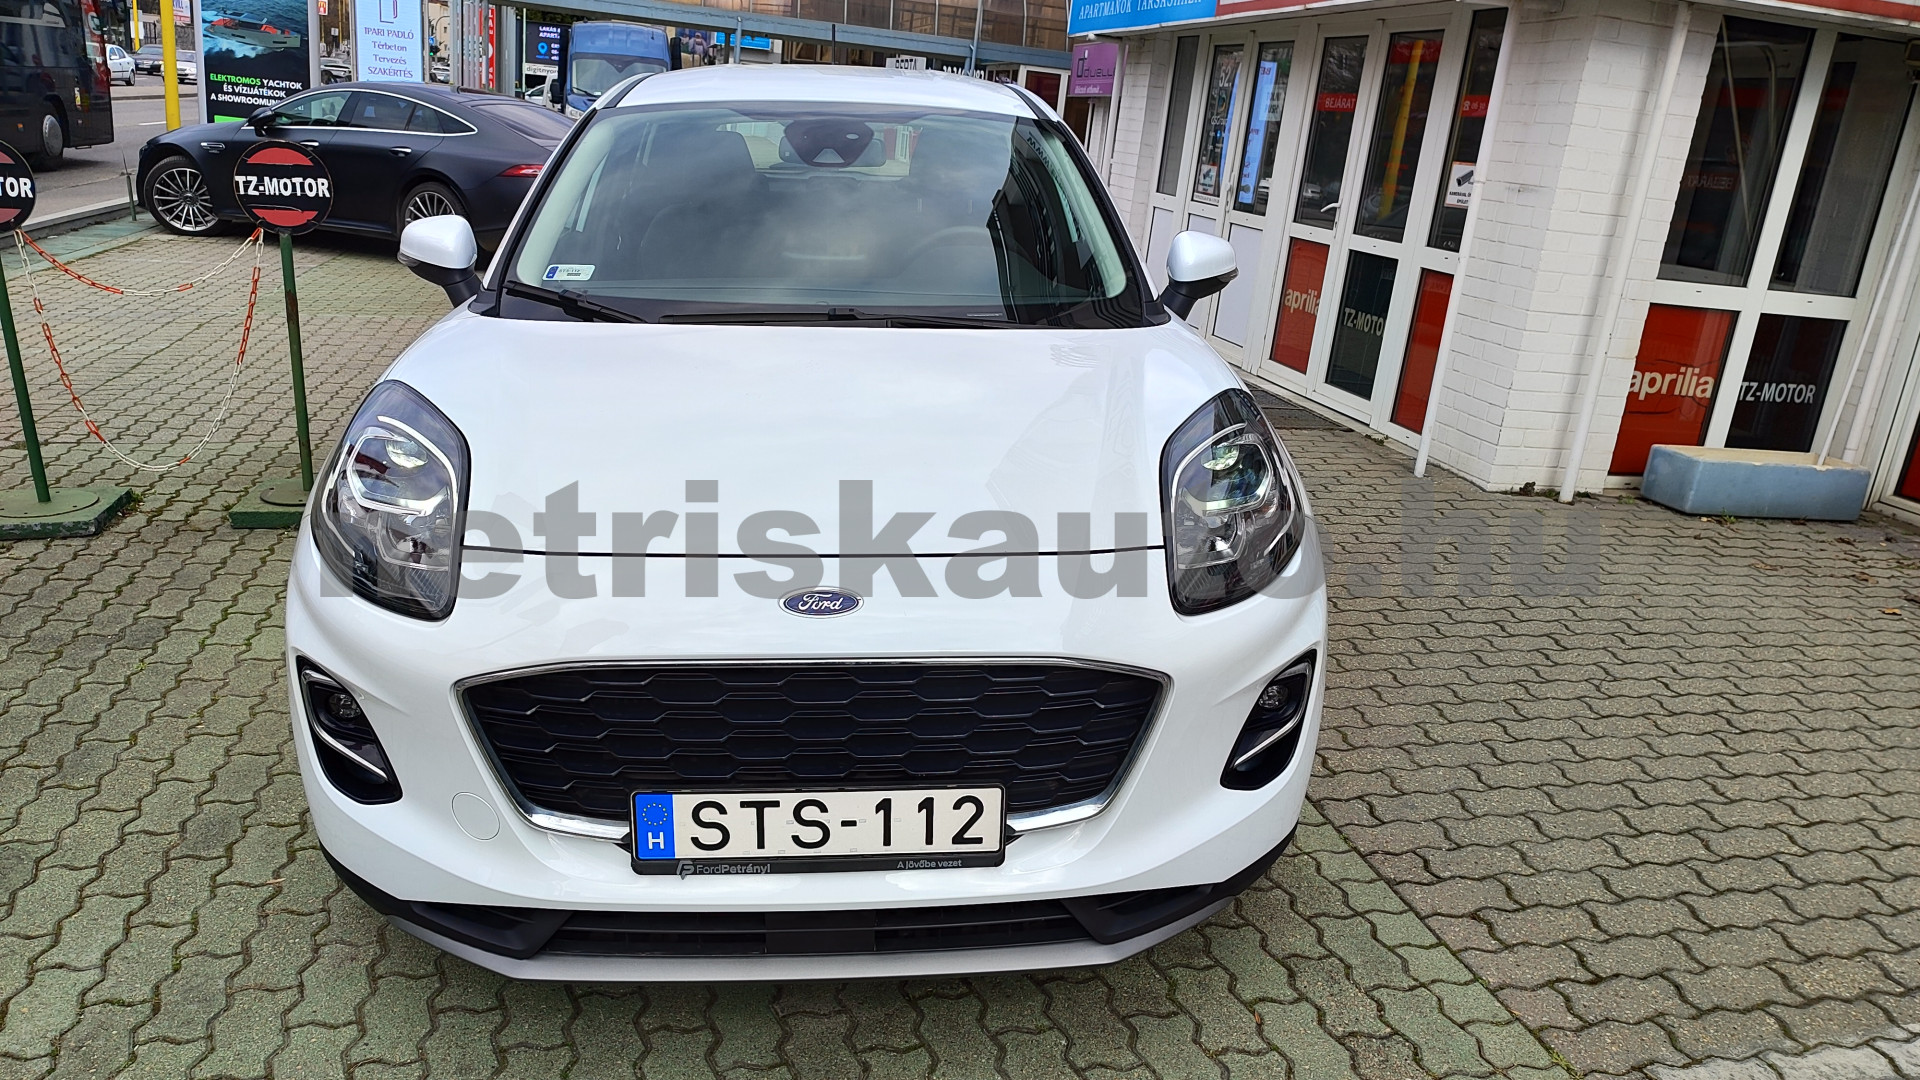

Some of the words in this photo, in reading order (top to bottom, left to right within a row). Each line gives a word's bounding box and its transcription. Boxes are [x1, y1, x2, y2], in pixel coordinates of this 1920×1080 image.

[1079, 0, 1132, 20] APARTMANOK
[364, 26, 385, 37] IPARI
[387, 29, 414, 40] PADLÓ
[372, 40, 407, 52] Térbeton
[373, 53, 407, 65] Tervezés
[367, 66, 413, 79] SZAKÉRTÉS
[210, 73, 261, 86] ELEKTROMOS
[262, 78, 303, 91] YACHTOK
[223, 82, 233, 93] ÉS
[234, 84, 286, 98] VÍZIJÁTÉKOK
[210, 92, 217, 101] A
[234, 175, 331, 198] TZ-MOTOR
[1343, 307, 1385, 337] TZ-MOTO
[1628, 366, 1715, 401] aprilia
[1738, 381, 1817, 405] TZ-MOTOR
[798, 593, 844, 611] Ford
[647, 831, 665, 851] H
[690, 795, 985, 852] STS-112
[897, 861, 905, 869] A
[937, 859, 962, 868] vezet
